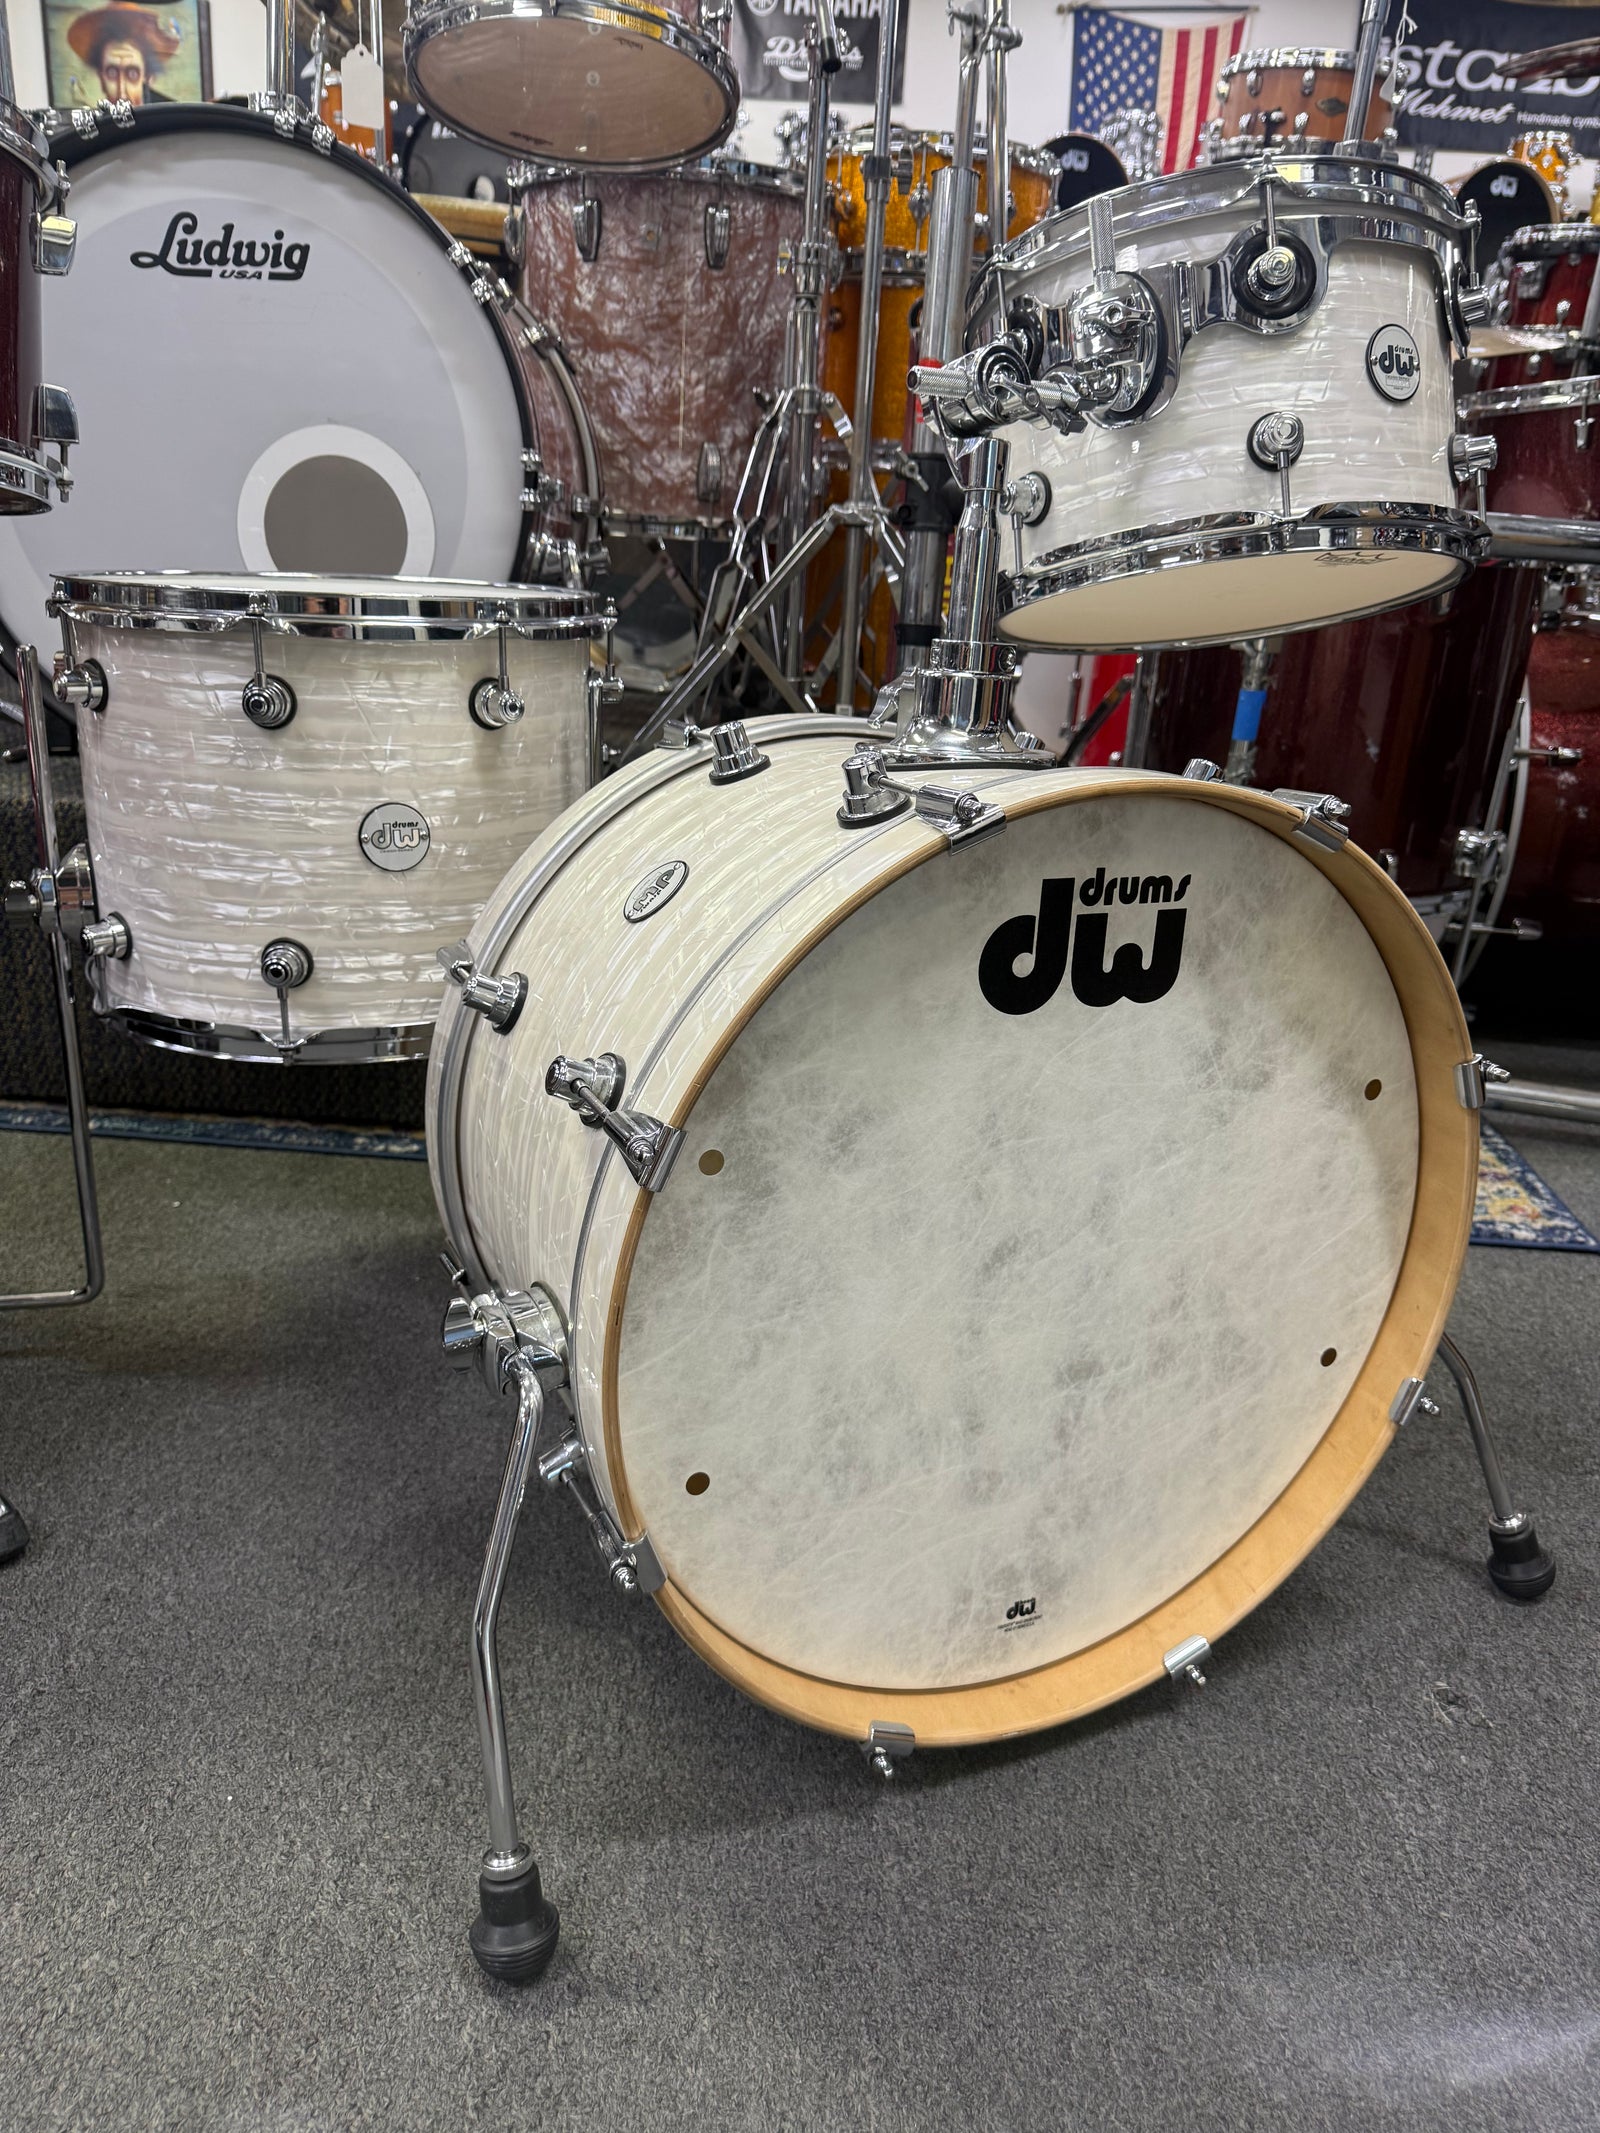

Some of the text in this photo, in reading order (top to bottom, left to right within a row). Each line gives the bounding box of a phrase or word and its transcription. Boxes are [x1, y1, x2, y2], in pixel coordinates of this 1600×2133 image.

[783, 0, 881, 18] YAAHA
[1399, 88, 1515, 125] Mehmet
[1061, 149, 1090, 172] dw
[1490, 175, 1519, 198] dw
[130, 211, 310, 280] Ludwig
[219, 269, 263, 280] USA
[1379, 345, 1414, 377] dw
[371, 823, 421, 850] dw
[392, 821, 419, 829] drums
[633, 869, 675, 911] dw
[1079, 867, 1192, 906] drums
[978, 877, 1187, 1015] dw
[1006, 1597, 1036, 1620] dw
